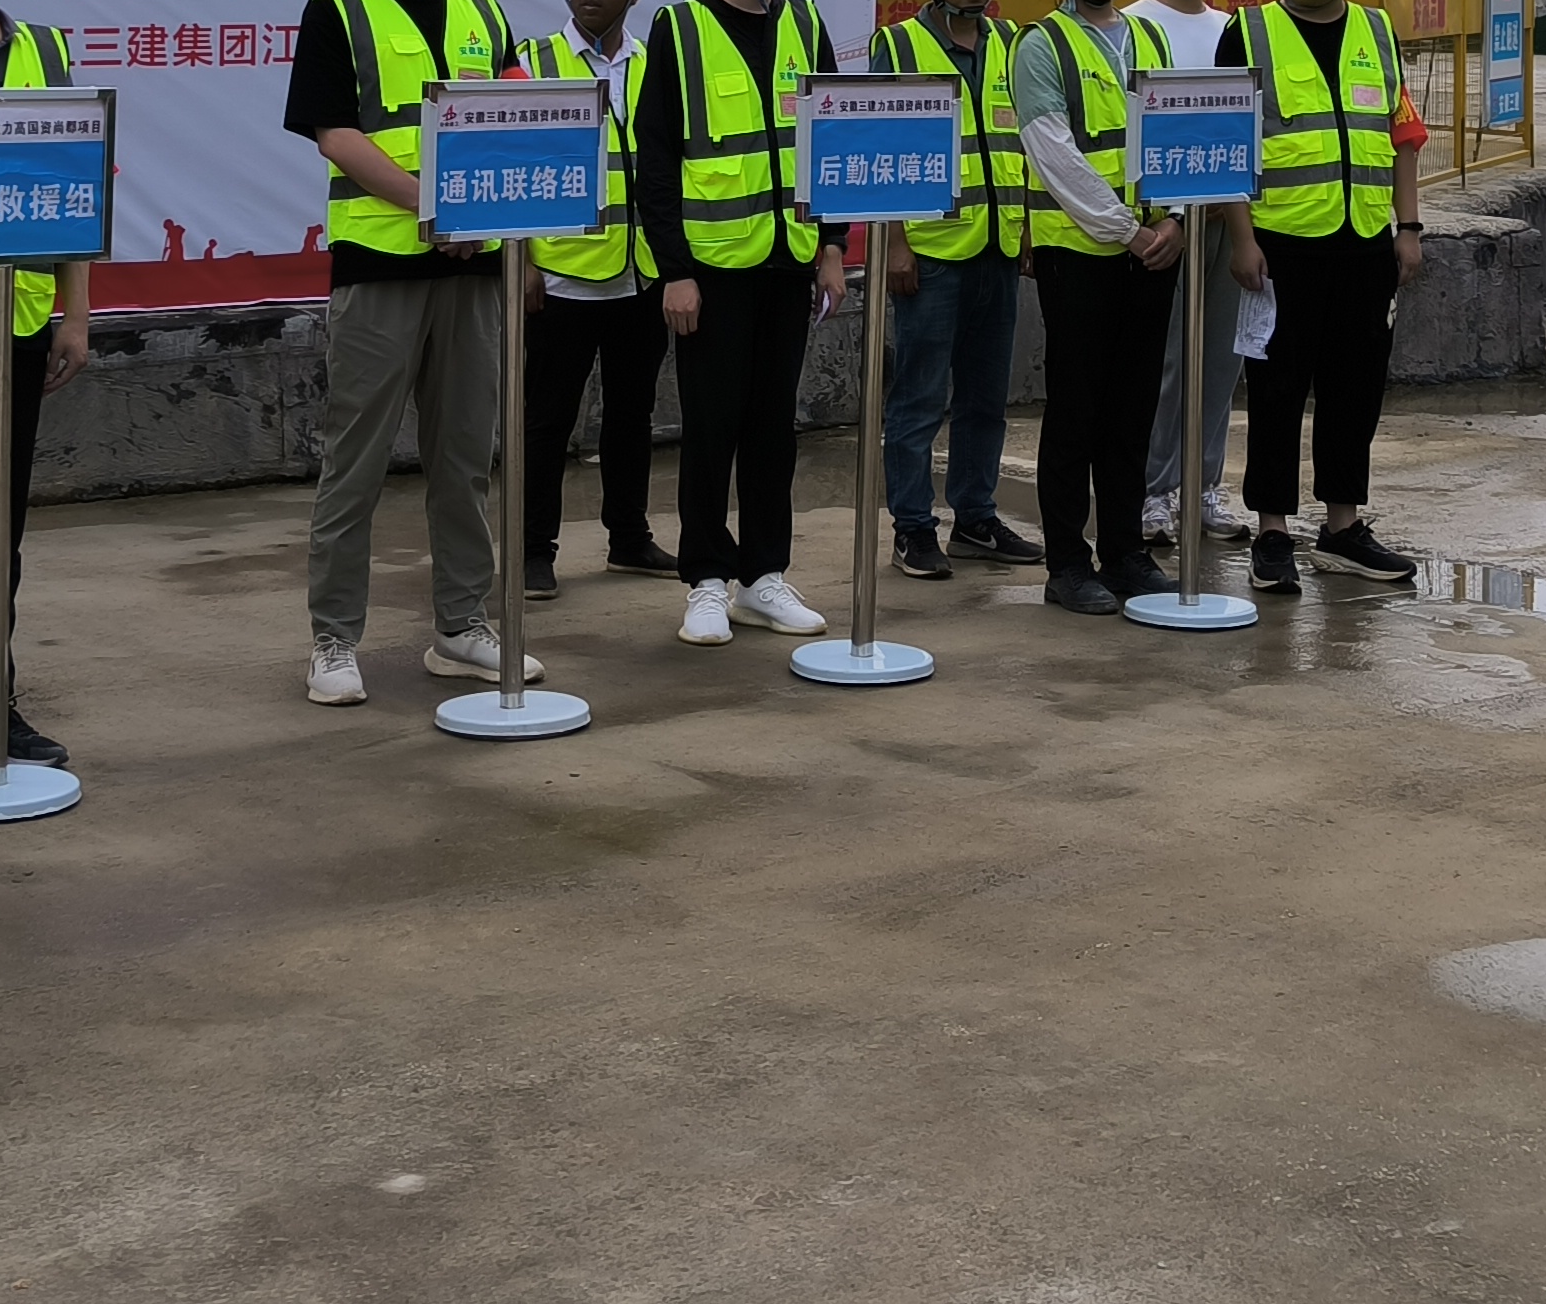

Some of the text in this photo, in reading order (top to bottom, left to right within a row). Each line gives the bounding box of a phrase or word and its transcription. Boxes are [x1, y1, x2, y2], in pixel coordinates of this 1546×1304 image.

[817, 152, 949, 186] 后勤保障组
[1144, 143, 1249, 176] 医疗救护组
[439, 165, 588, 204] 通讯联络组
